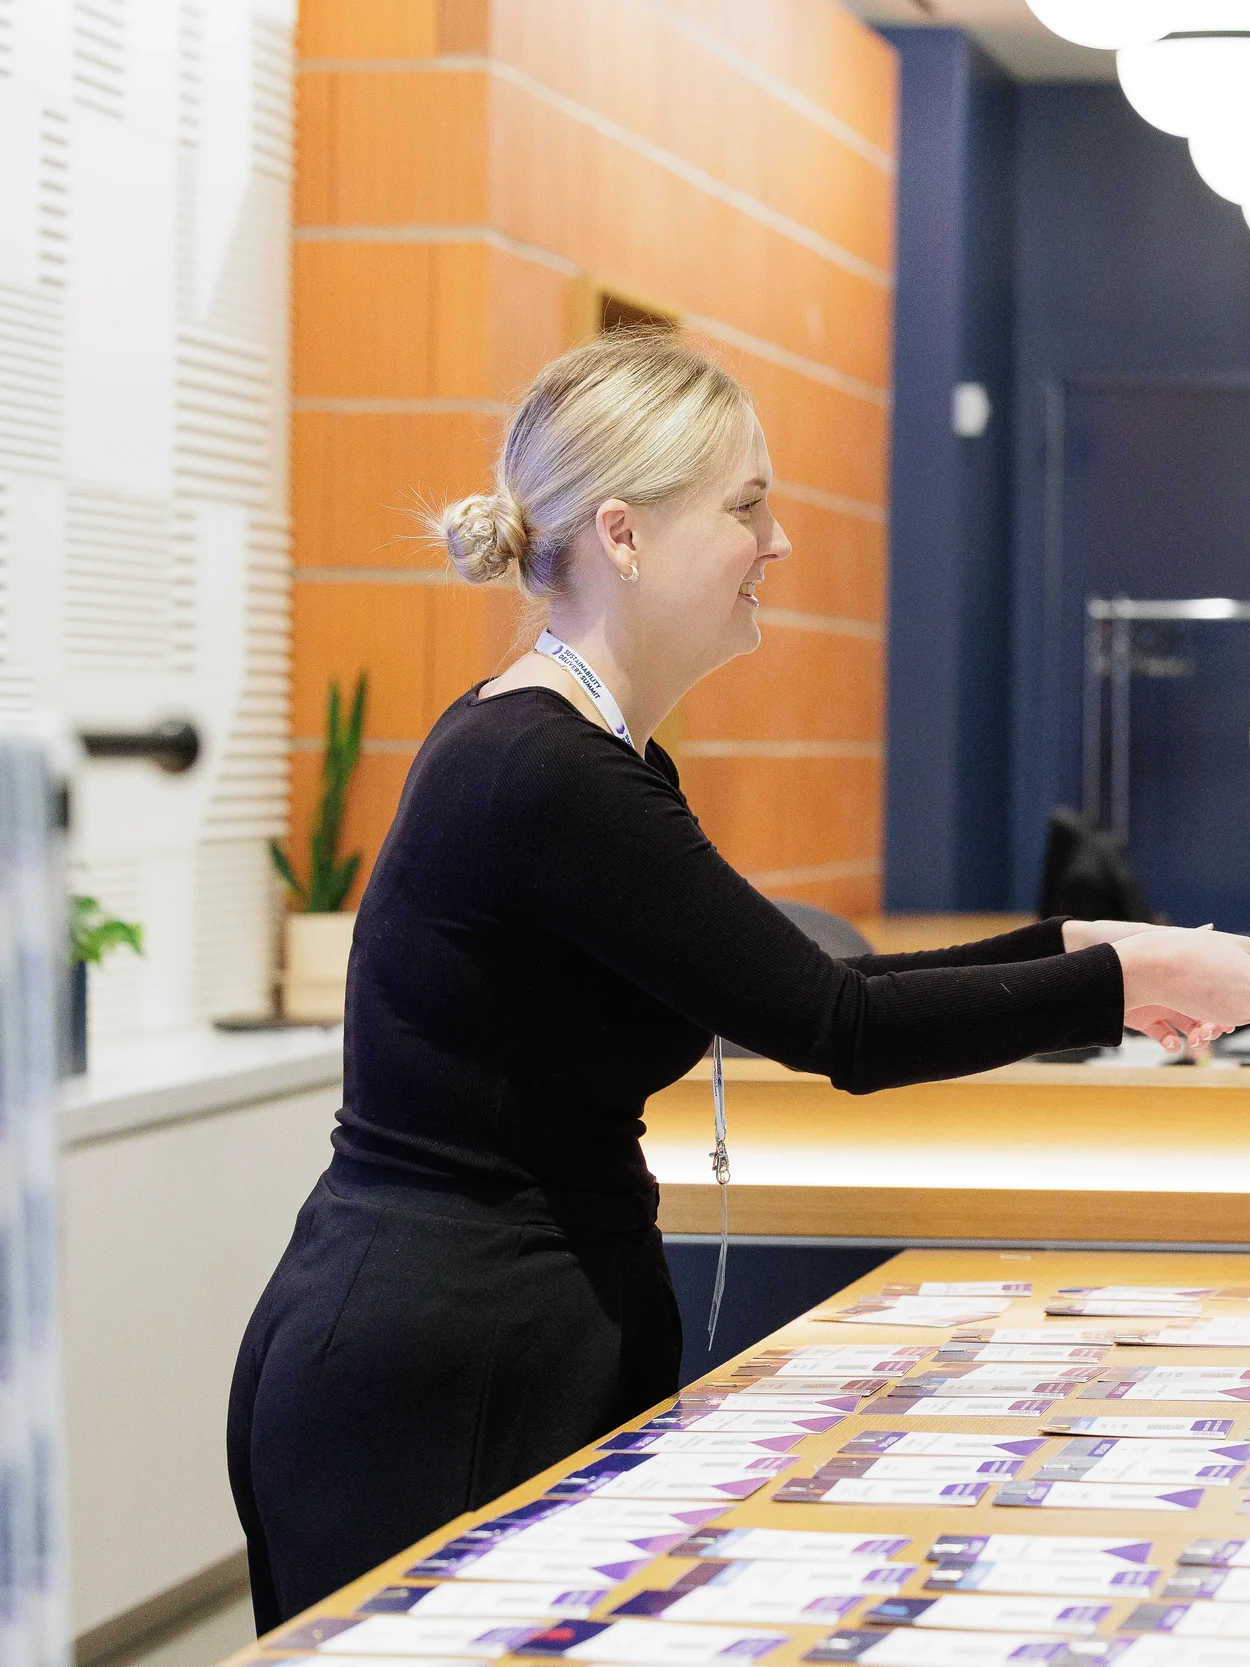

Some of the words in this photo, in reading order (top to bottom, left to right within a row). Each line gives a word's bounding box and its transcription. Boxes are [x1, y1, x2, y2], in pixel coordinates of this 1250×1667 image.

[558, 653, 583, 676] DELIVERY
[580, 675, 601, 699] SUMMIT
[564, 649, 602, 689] SUSTAINABILITY
